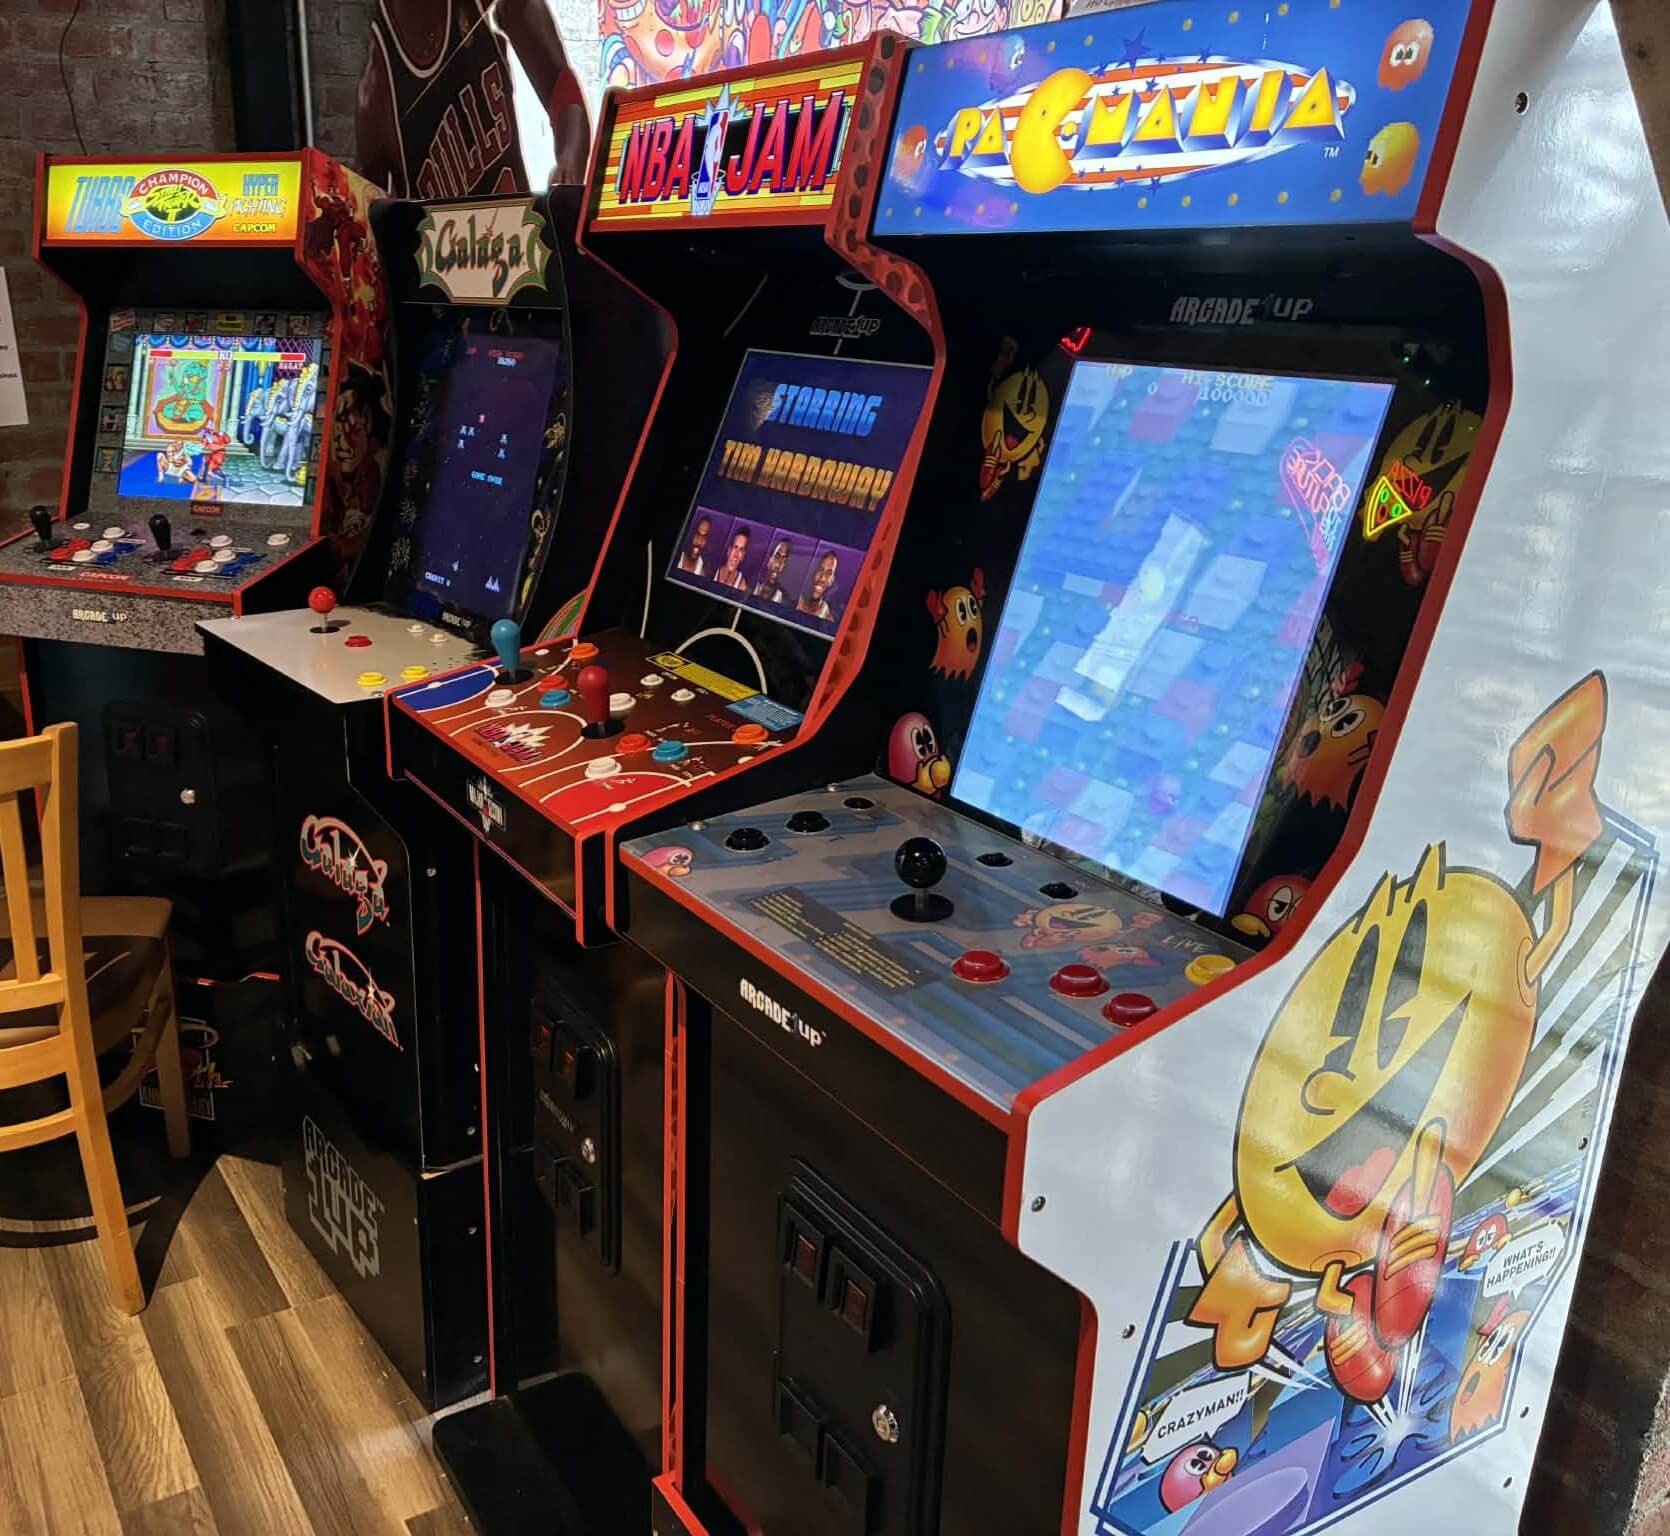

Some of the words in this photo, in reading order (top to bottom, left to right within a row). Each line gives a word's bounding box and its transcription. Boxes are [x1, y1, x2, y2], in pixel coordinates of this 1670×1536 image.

[619, 113, 695, 205] NBA
[725, 89, 847, 196] JAM
[138, 172, 210, 195] CHAMPION
[242, 174, 279, 197] HYPER
[142, 219, 202, 237] EDITION
[228, 197, 287, 218] FIGHTING
[232, 223, 277, 234] CAPCOM
[434, 213, 524, 299] Galaga
[766, 383, 884, 438] STARRING
[717, 439, 763, 483] TIM
[756, 447, 895, 513] HARDAWAY
[300, 814, 391, 936] Galaga
[1486, 1246, 1557, 1289] HAPPENING!!
[1503, 1240, 1544, 1268] WHAT'S
[1156, 1388, 1245, 1439] CRAZYMAN!!
